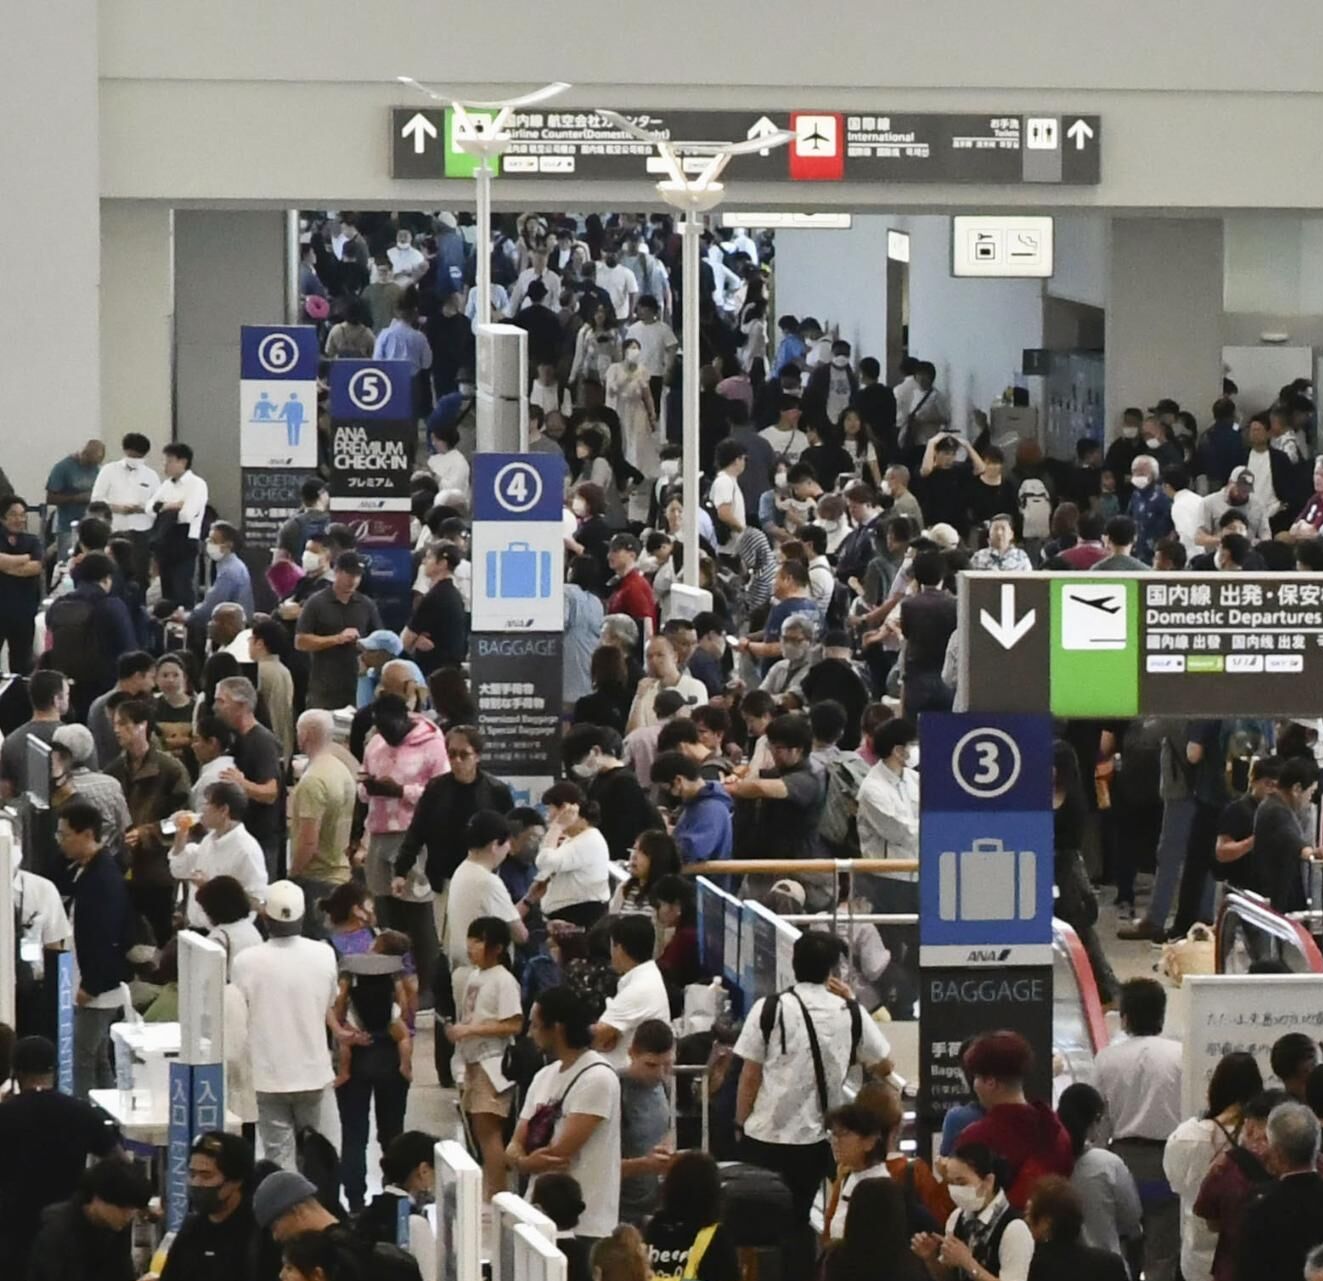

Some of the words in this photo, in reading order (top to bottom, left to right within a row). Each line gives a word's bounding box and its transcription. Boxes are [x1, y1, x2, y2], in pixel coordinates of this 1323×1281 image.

[847, 131, 915, 143] International
[271, 342, 286, 364] 6
[361, 375, 379, 400] 5
[334, 427, 368, 441] ANA
[334, 440, 404, 456] PREMIUM
[334, 454, 408, 470] CHECK-IN
[347, 477, 394, 488] プレミアム
[506, 474, 527, 503] 4
[1146, 585, 1211, 606] 国内線
[1146, 610, 1224, 625] Domestic
[1228, 610, 1322, 626] Departures
[478, 640, 557, 656] BAGGAGE
[974, 742, 1000, 784] 3
[966, 950, 997, 961] ANA
[931, 979, 1043, 1002] BAGGAGE
[59, 1024, 73, 1095] ENTRA
[172, 1078, 188, 1127] 入口
[197, 1080, 218, 1127] 入口
[168, 1140, 187, 1232] ENTRA
